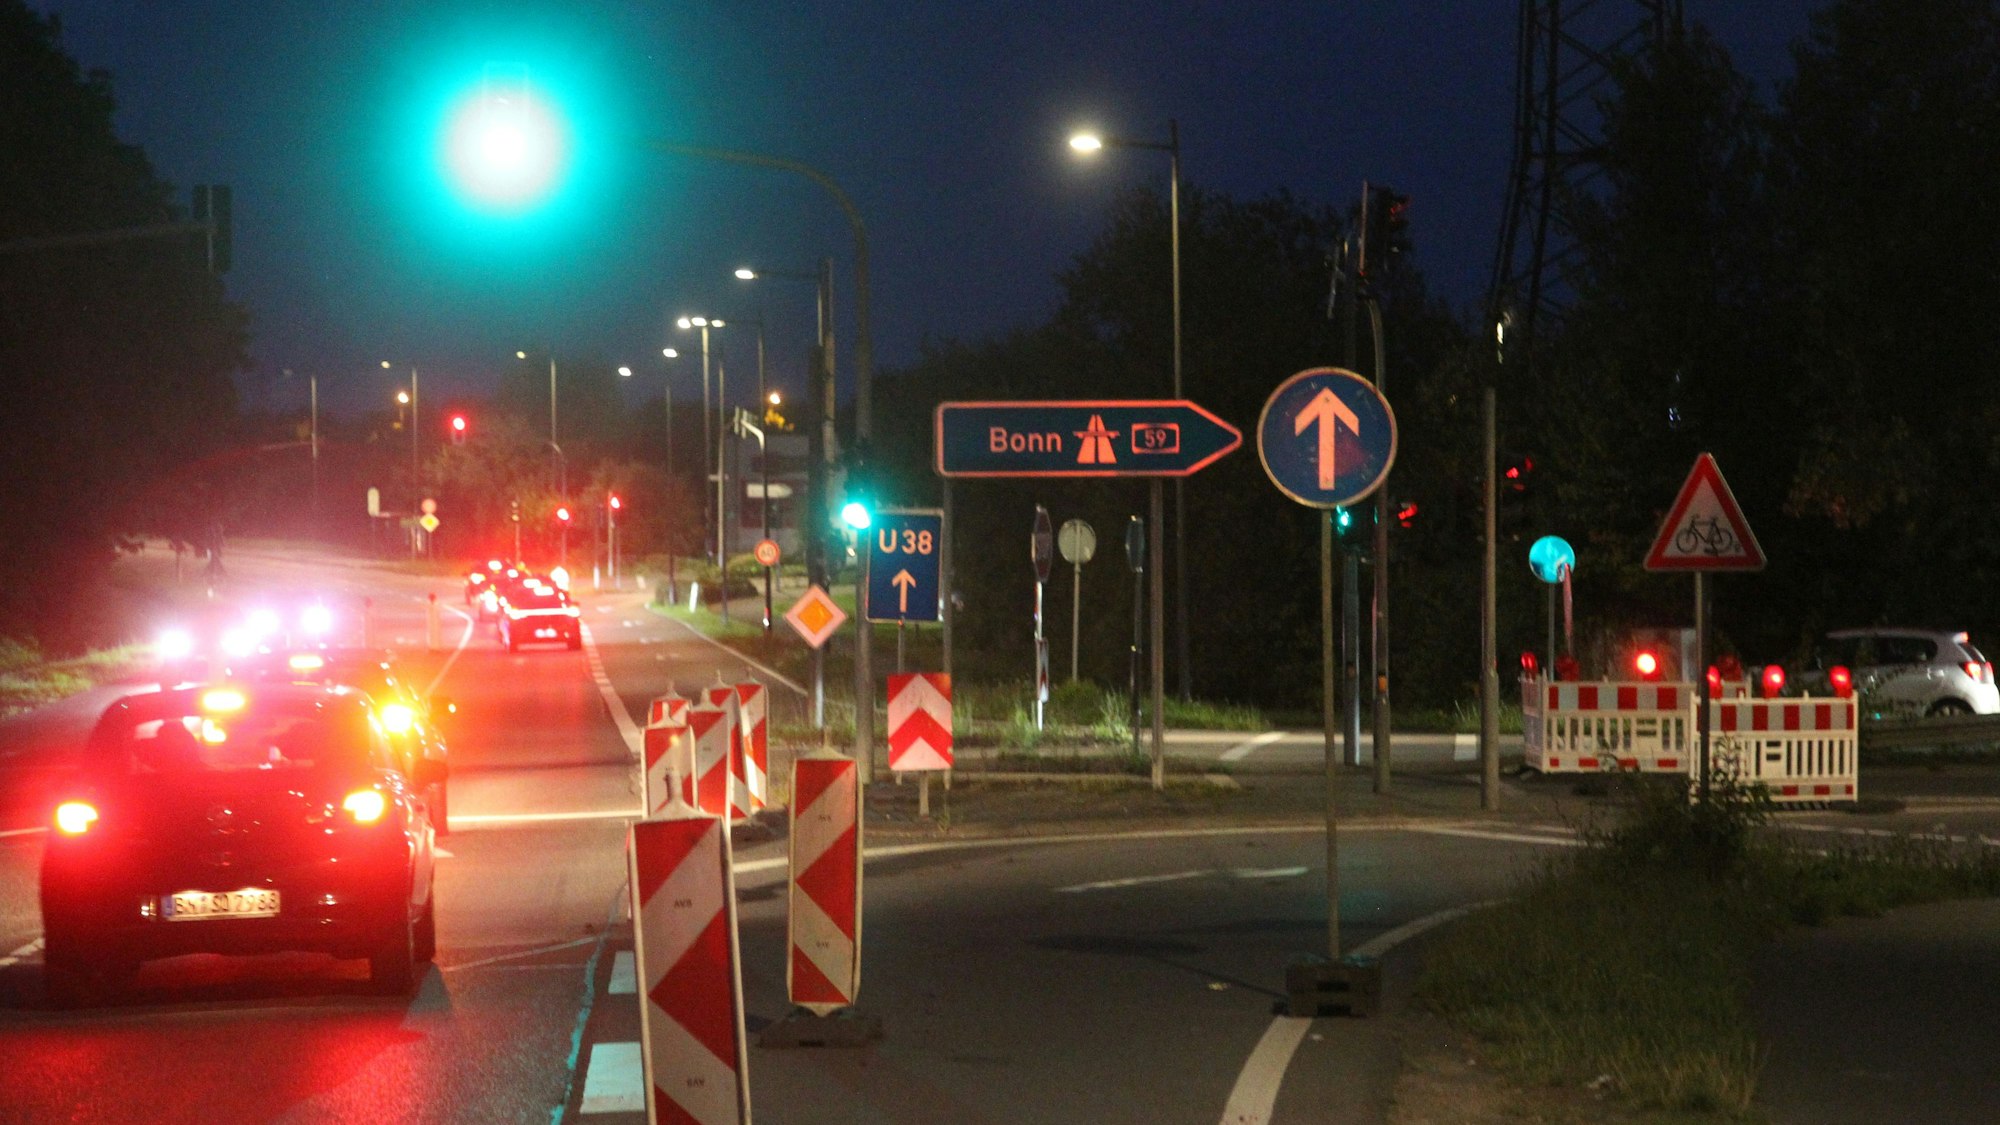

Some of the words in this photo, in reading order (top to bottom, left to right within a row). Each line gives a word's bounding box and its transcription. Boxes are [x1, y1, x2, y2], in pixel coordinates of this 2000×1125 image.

[989, 426, 1062, 452] Bonn
[1144, 429, 1167, 448] 59
[879, 528, 897, 553] U
[902, 529, 932, 555] 38
